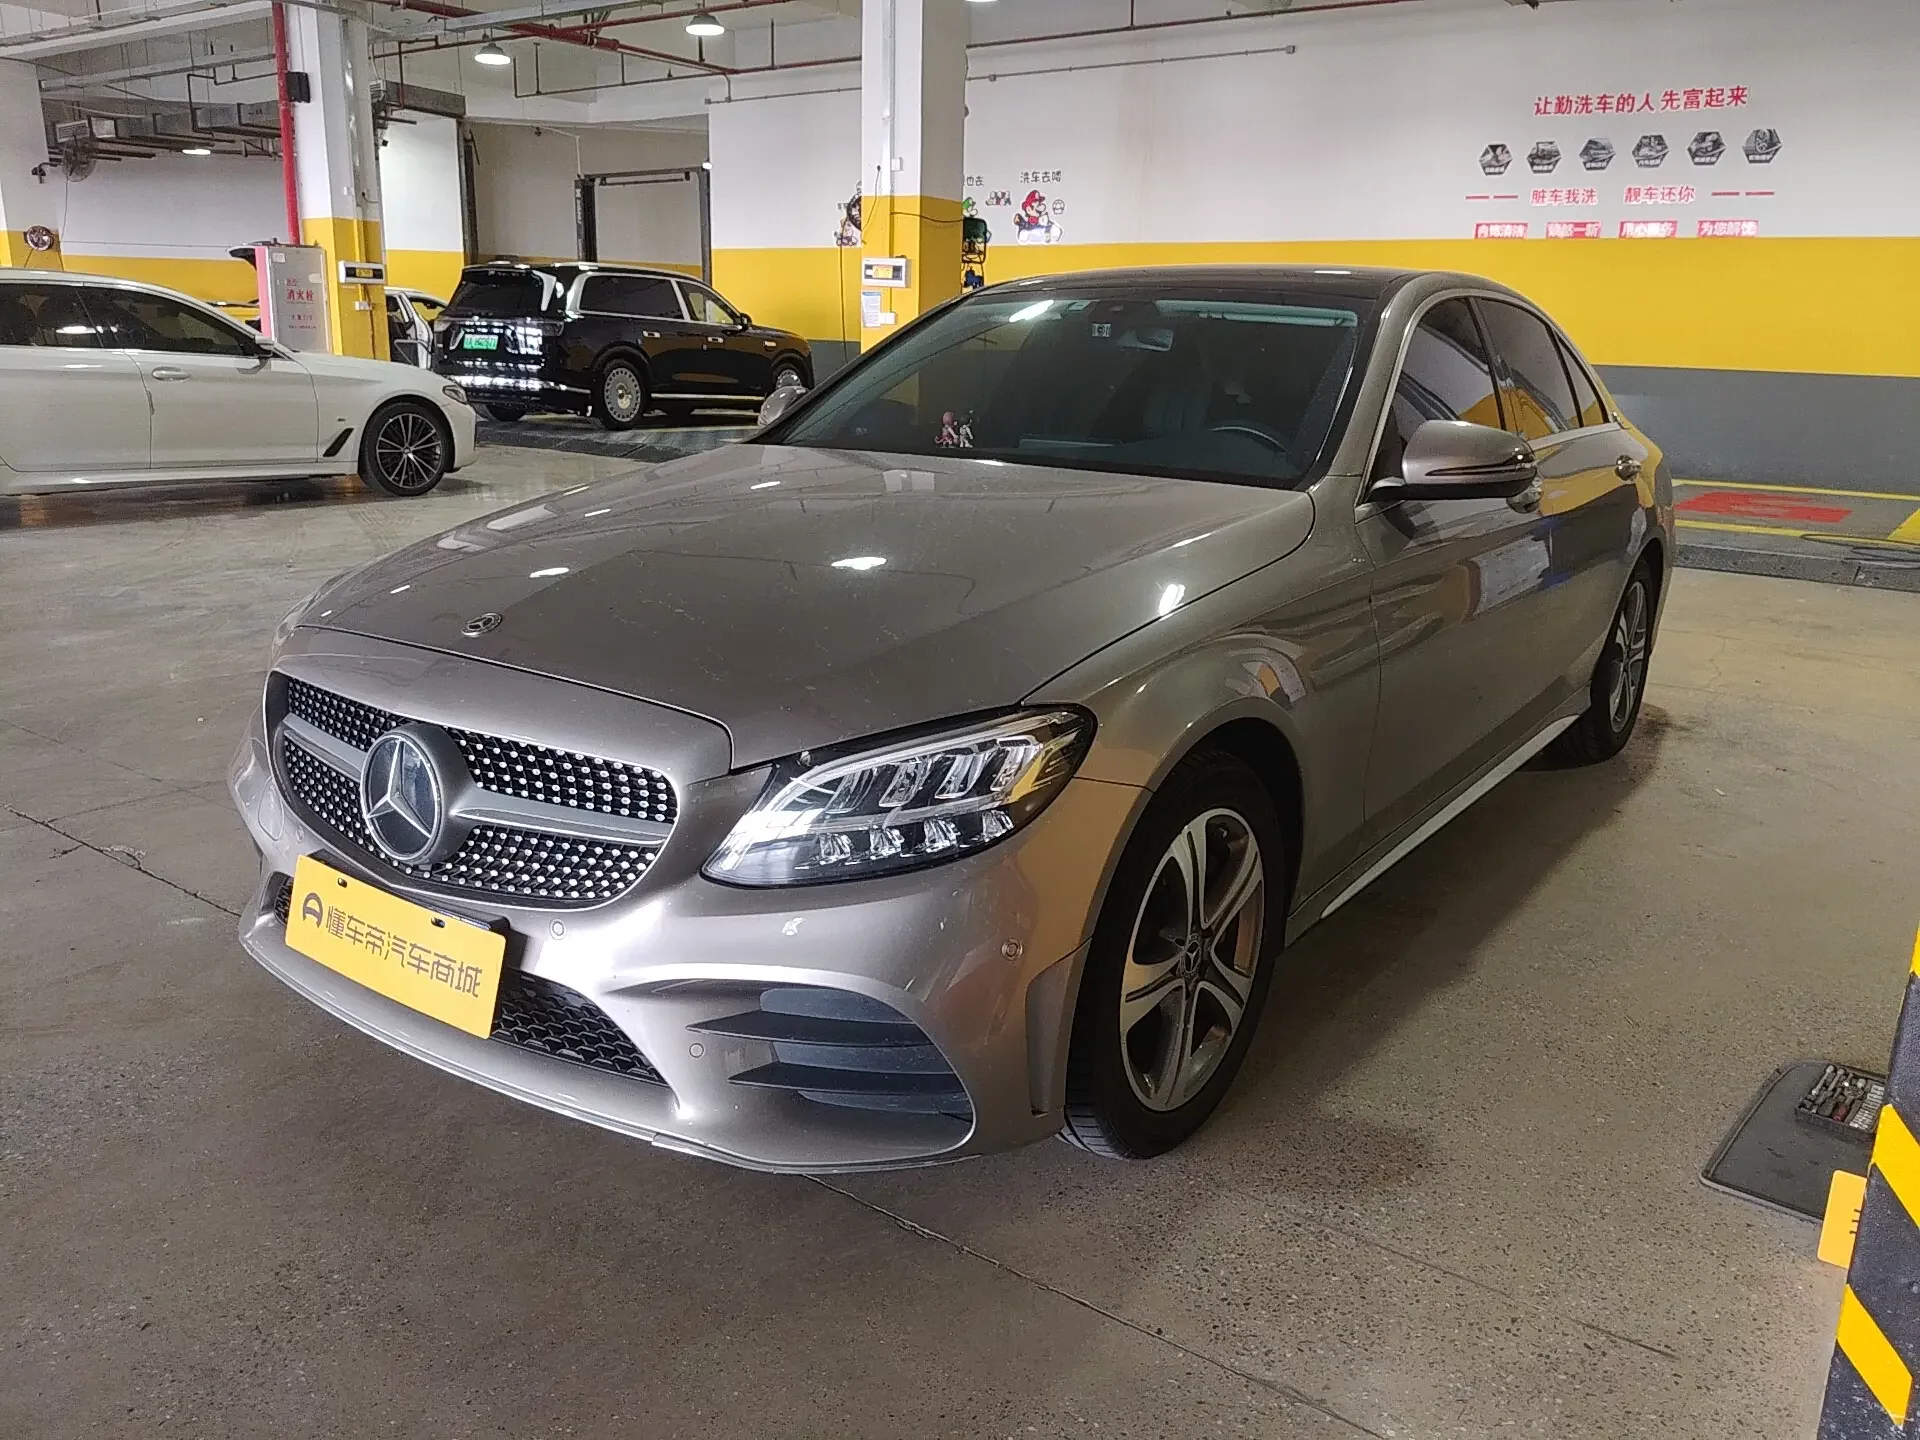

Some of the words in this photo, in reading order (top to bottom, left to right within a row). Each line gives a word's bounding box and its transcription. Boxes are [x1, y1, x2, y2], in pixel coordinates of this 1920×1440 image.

[1533, 86, 1748, 116] 让勤洗车的人先富起来
[1624, 186, 1695, 204] 靓车还你
[326, 905, 483, 998] 懂车帝汽车商城
